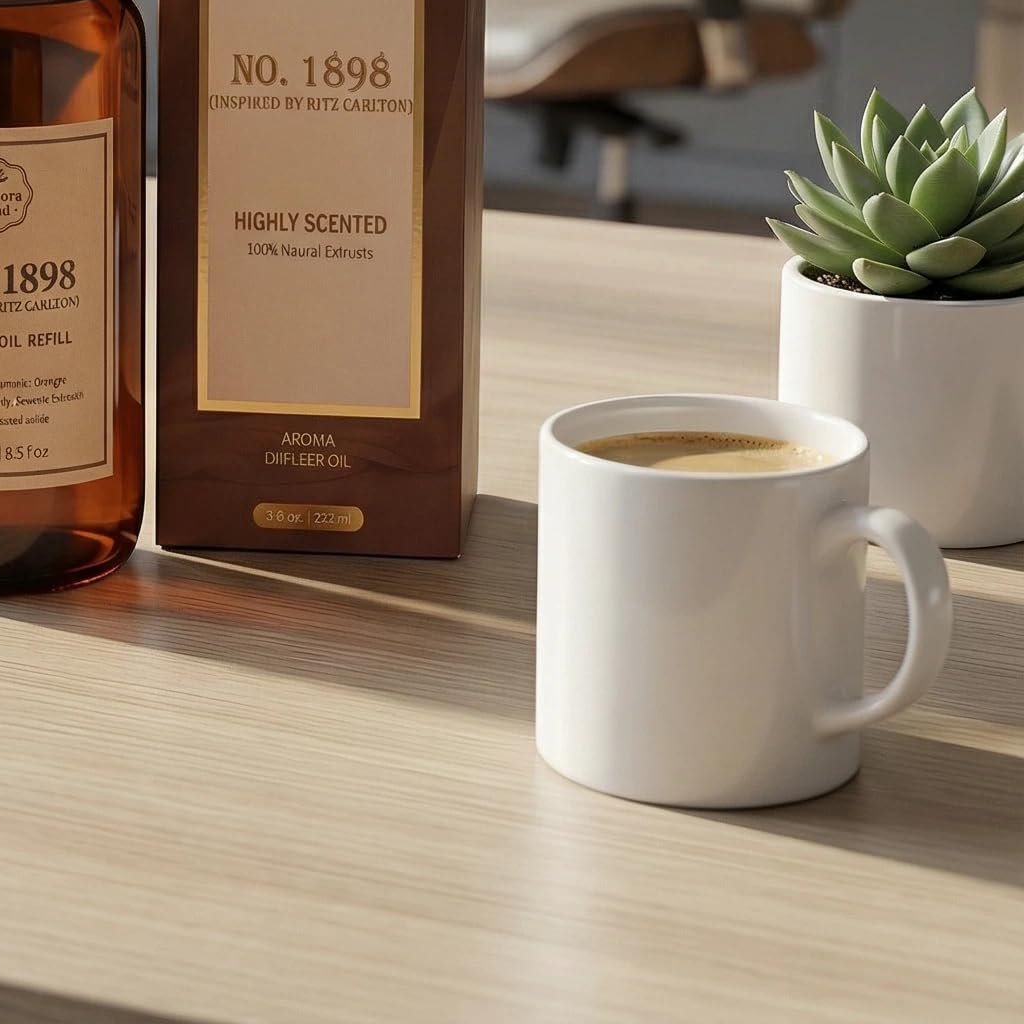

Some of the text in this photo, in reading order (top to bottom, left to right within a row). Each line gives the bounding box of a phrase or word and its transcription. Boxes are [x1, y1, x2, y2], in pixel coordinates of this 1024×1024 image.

[230, 50, 392, 93] NO. 1898
[285, 96, 304, 111] BY
[306, 97, 340, 112] RITZ
[234, 211, 387, 235] HIGHLY SCENTED
[281, 243, 321, 258] Naural
[325, 245, 374, 260] Extrusts
[3, 259, 76, 295] 1898
[28, 331, 73, 347] REFILL
[281, 432, 336, 448] AROMA
[4, 445, 24, 460] 8.5
[327, 454, 352, 468] OIL
[337, 513, 351, 525] ml
